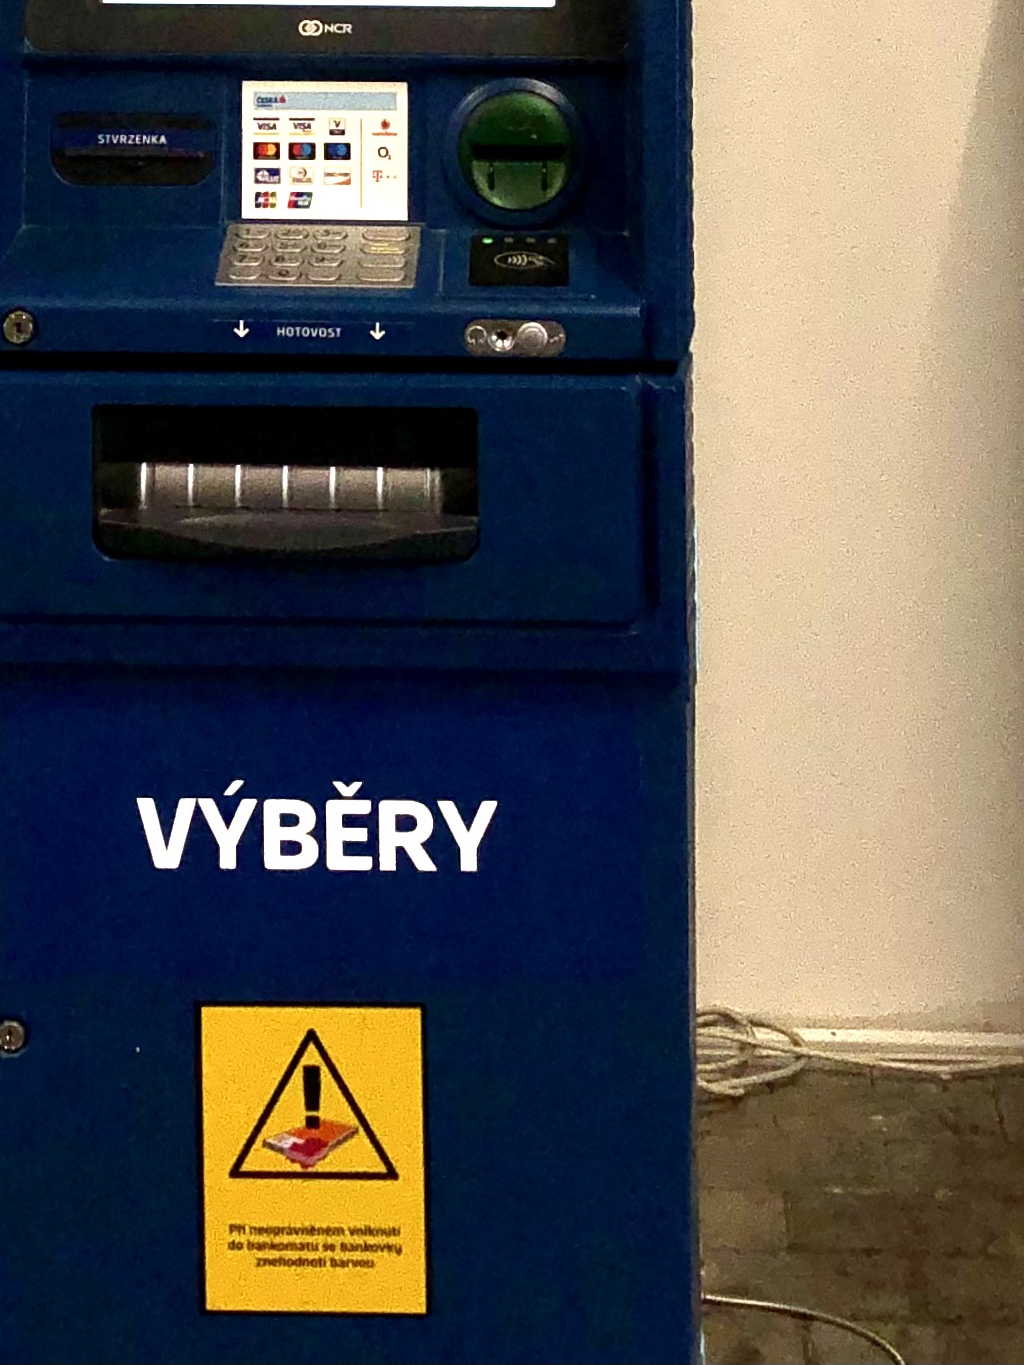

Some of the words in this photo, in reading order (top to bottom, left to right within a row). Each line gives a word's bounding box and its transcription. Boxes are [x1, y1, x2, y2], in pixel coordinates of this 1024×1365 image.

[324, 23, 352, 34] NCR
[257, 122, 277, 130] VISA
[292, 122, 312, 130] VISA
[97, 133, 167, 145] STVRZENKA
[276, 327, 342, 338] HOTOVOST
[136, 779, 498, 872] VÝBĚRY
[228, 1240, 243, 1251] do
[247, 1241, 319, 1252] bankomatu
[322, 1243, 336, 1252] se
[340, 1241, 403, 1256] bankovky
